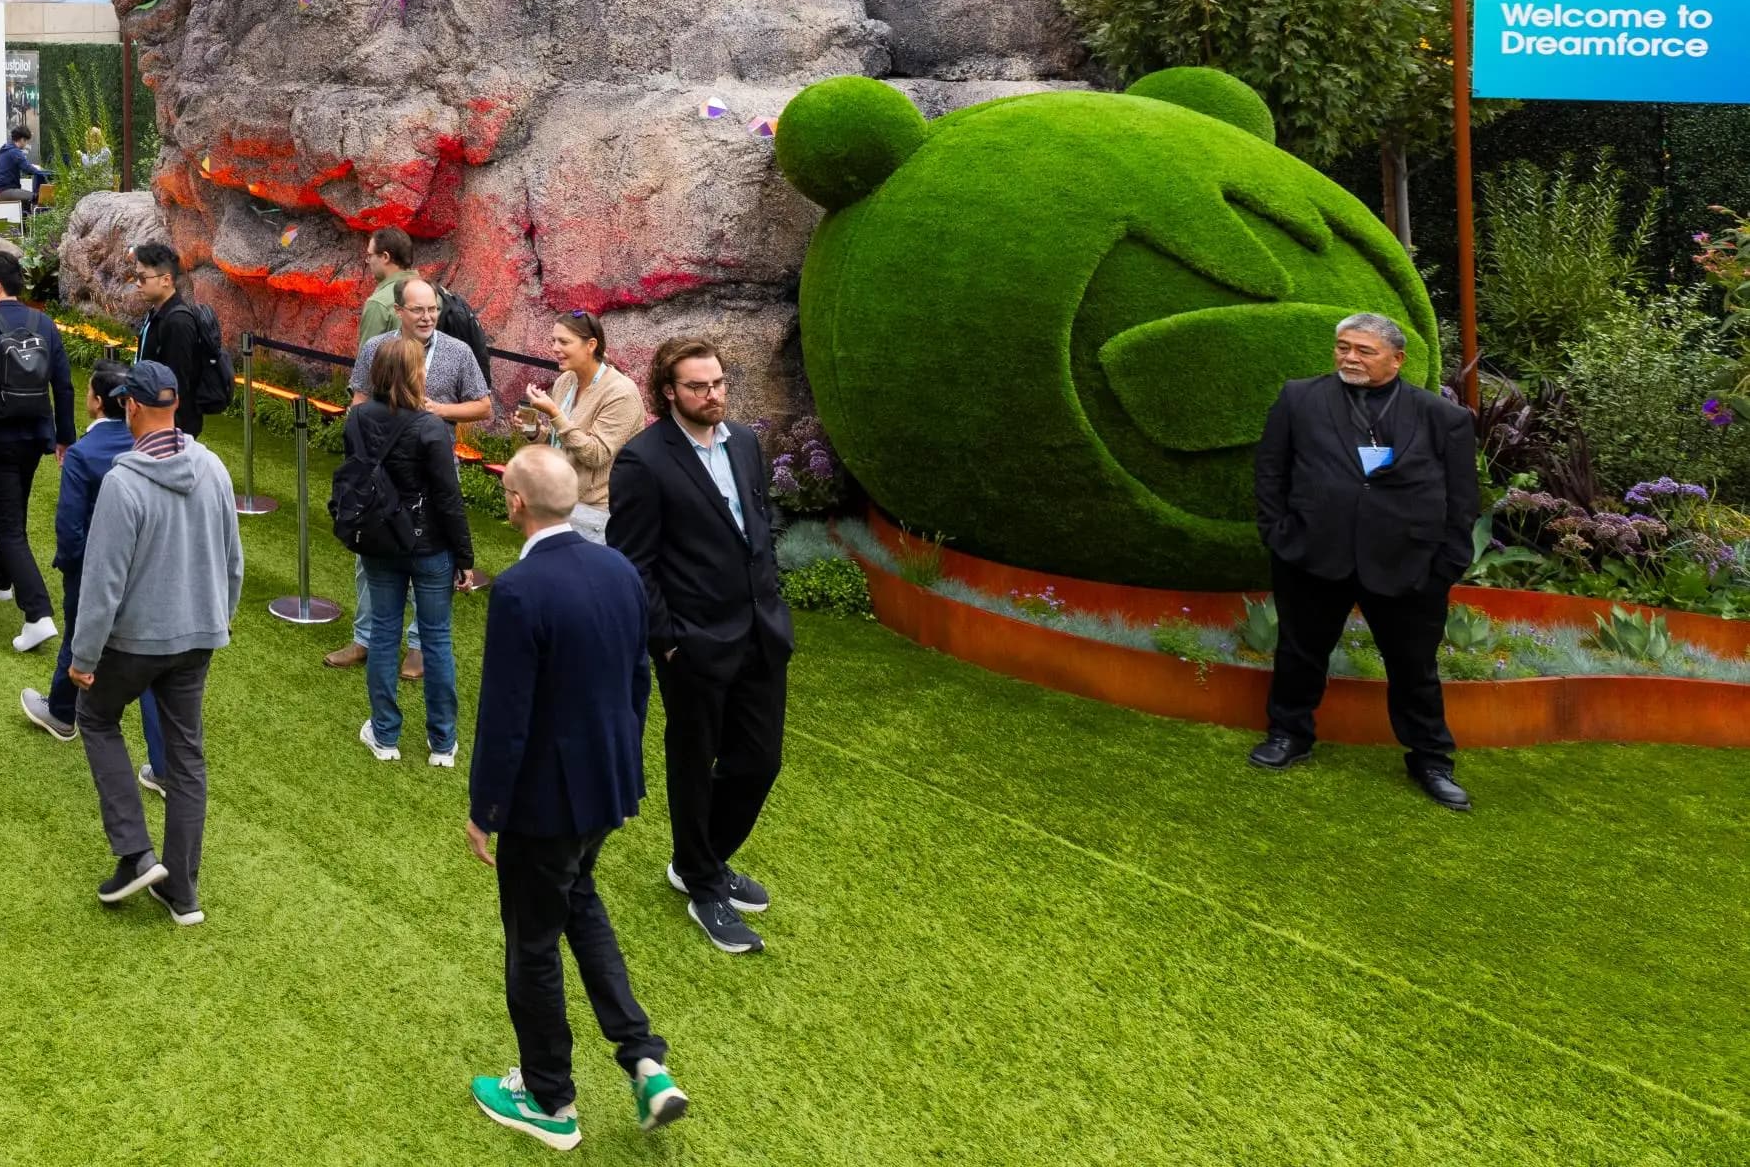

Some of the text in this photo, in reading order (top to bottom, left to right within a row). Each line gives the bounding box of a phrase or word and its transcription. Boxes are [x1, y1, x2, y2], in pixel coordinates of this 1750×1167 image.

[1500, 2, 1713, 29] Welcome to
[1500, 30, 1709, 58] Dreamforce
[5, 58, 31, 73] ustpilot
